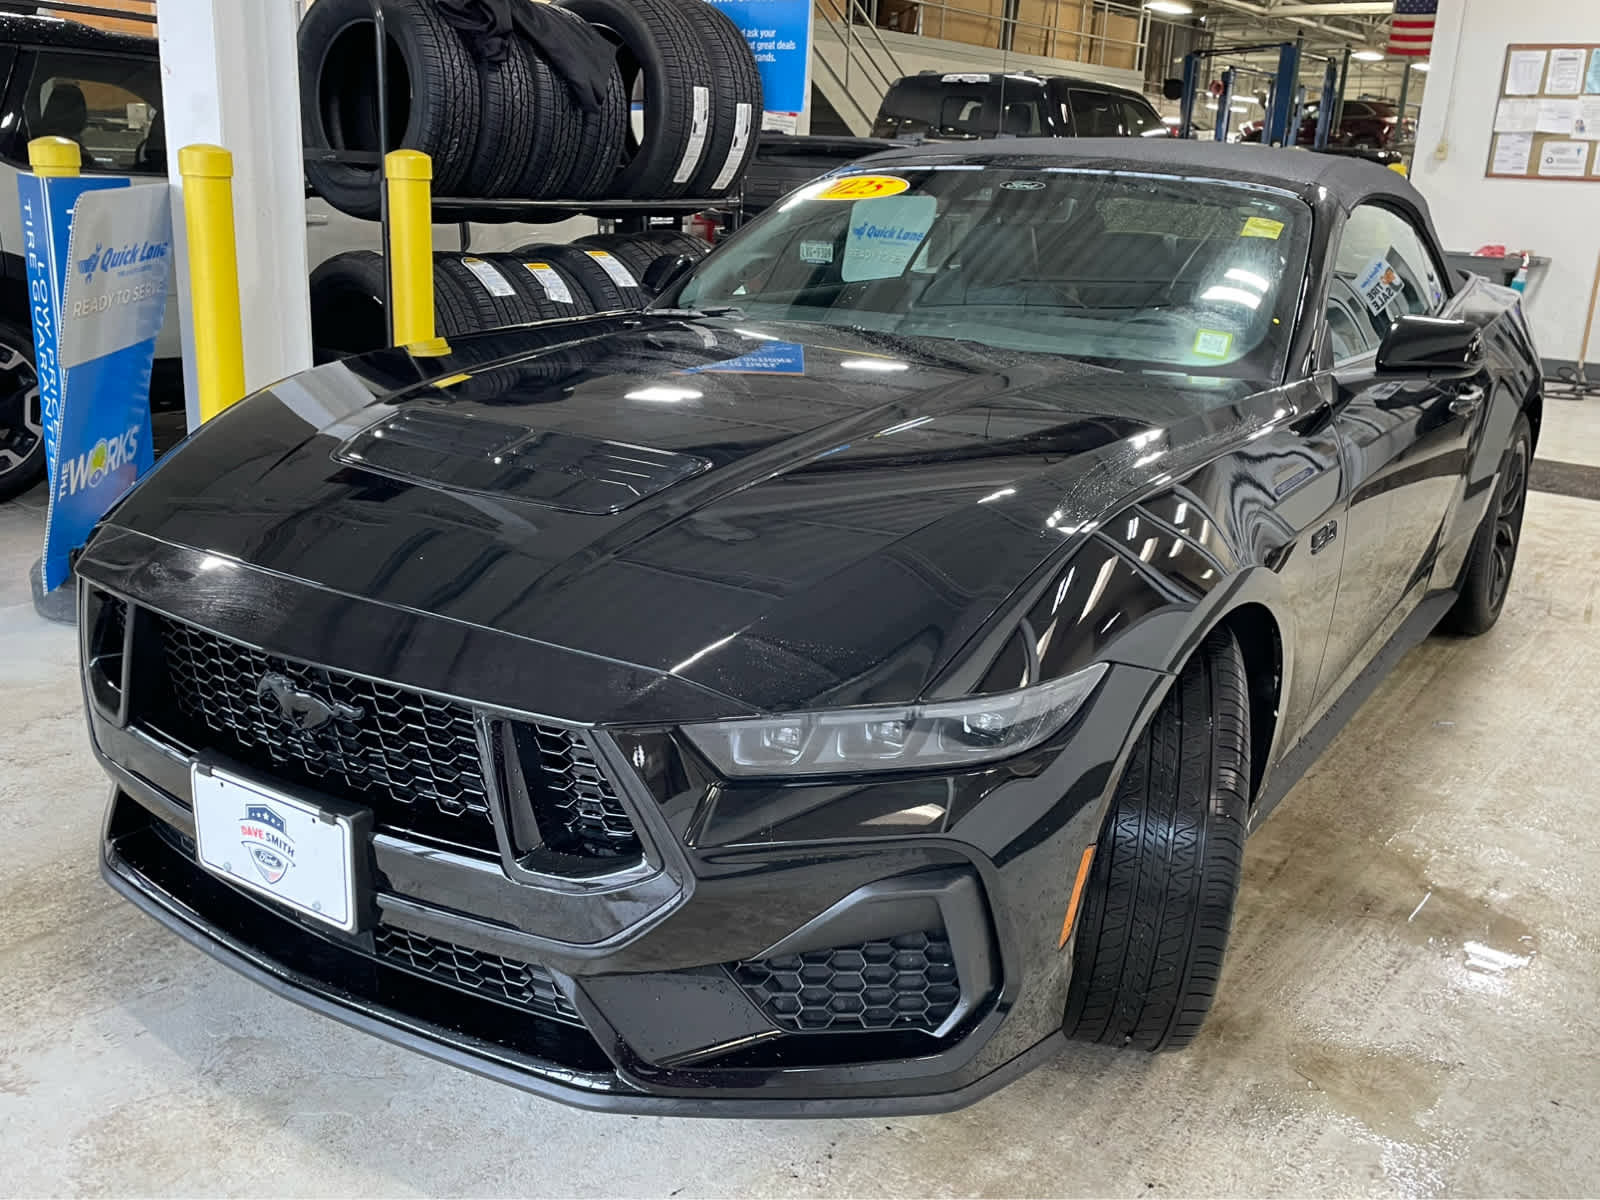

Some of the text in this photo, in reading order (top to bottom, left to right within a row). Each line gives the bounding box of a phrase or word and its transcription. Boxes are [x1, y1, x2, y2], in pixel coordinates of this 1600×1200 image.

[746, 28, 759, 38] ask
[760, 29, 776, 40] your
[756, 41, 775, 51] great
[777, 40, 796, 50] deals
[24, 200, 37, 269] TIRE
[867, 225, 895, 239] Quick
[101, 242, 138, 272] Quick
[37, 260, 52, 338] LOW
[73, 294, 115, 318] READY
[114, 289, 130, 304] TO
[60, 424, 143, 497] THE WORKS
[240, 825, 295, 858] DAVE SMITH
